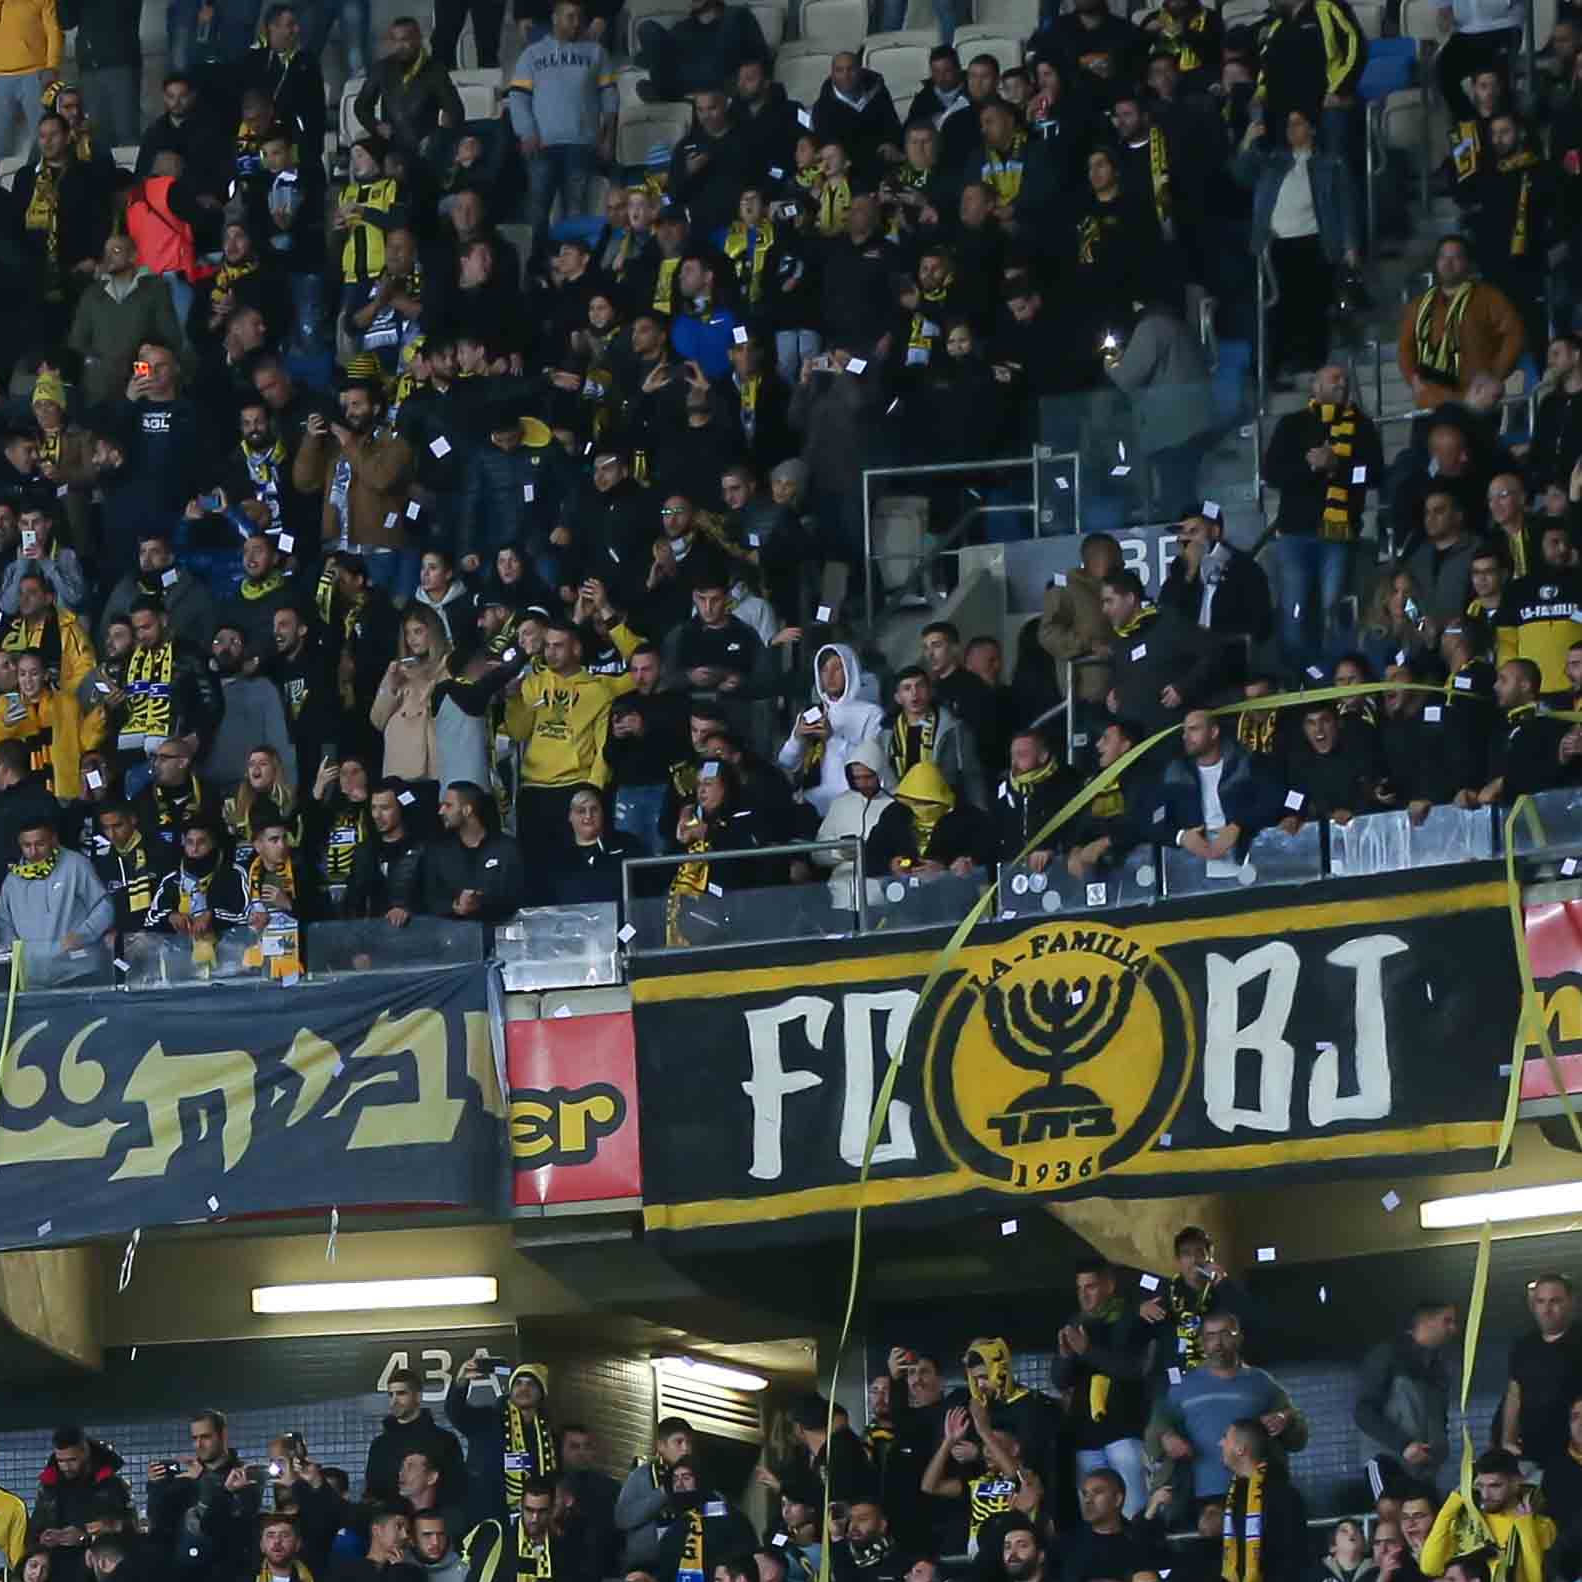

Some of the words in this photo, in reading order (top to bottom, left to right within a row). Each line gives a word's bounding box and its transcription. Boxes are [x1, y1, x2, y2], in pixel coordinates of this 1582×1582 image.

[742, 988, 920, 1180] FC
[1205, 934, 1409, 1133] BJ
[1011, 1154, 1094, 1189] 1936
